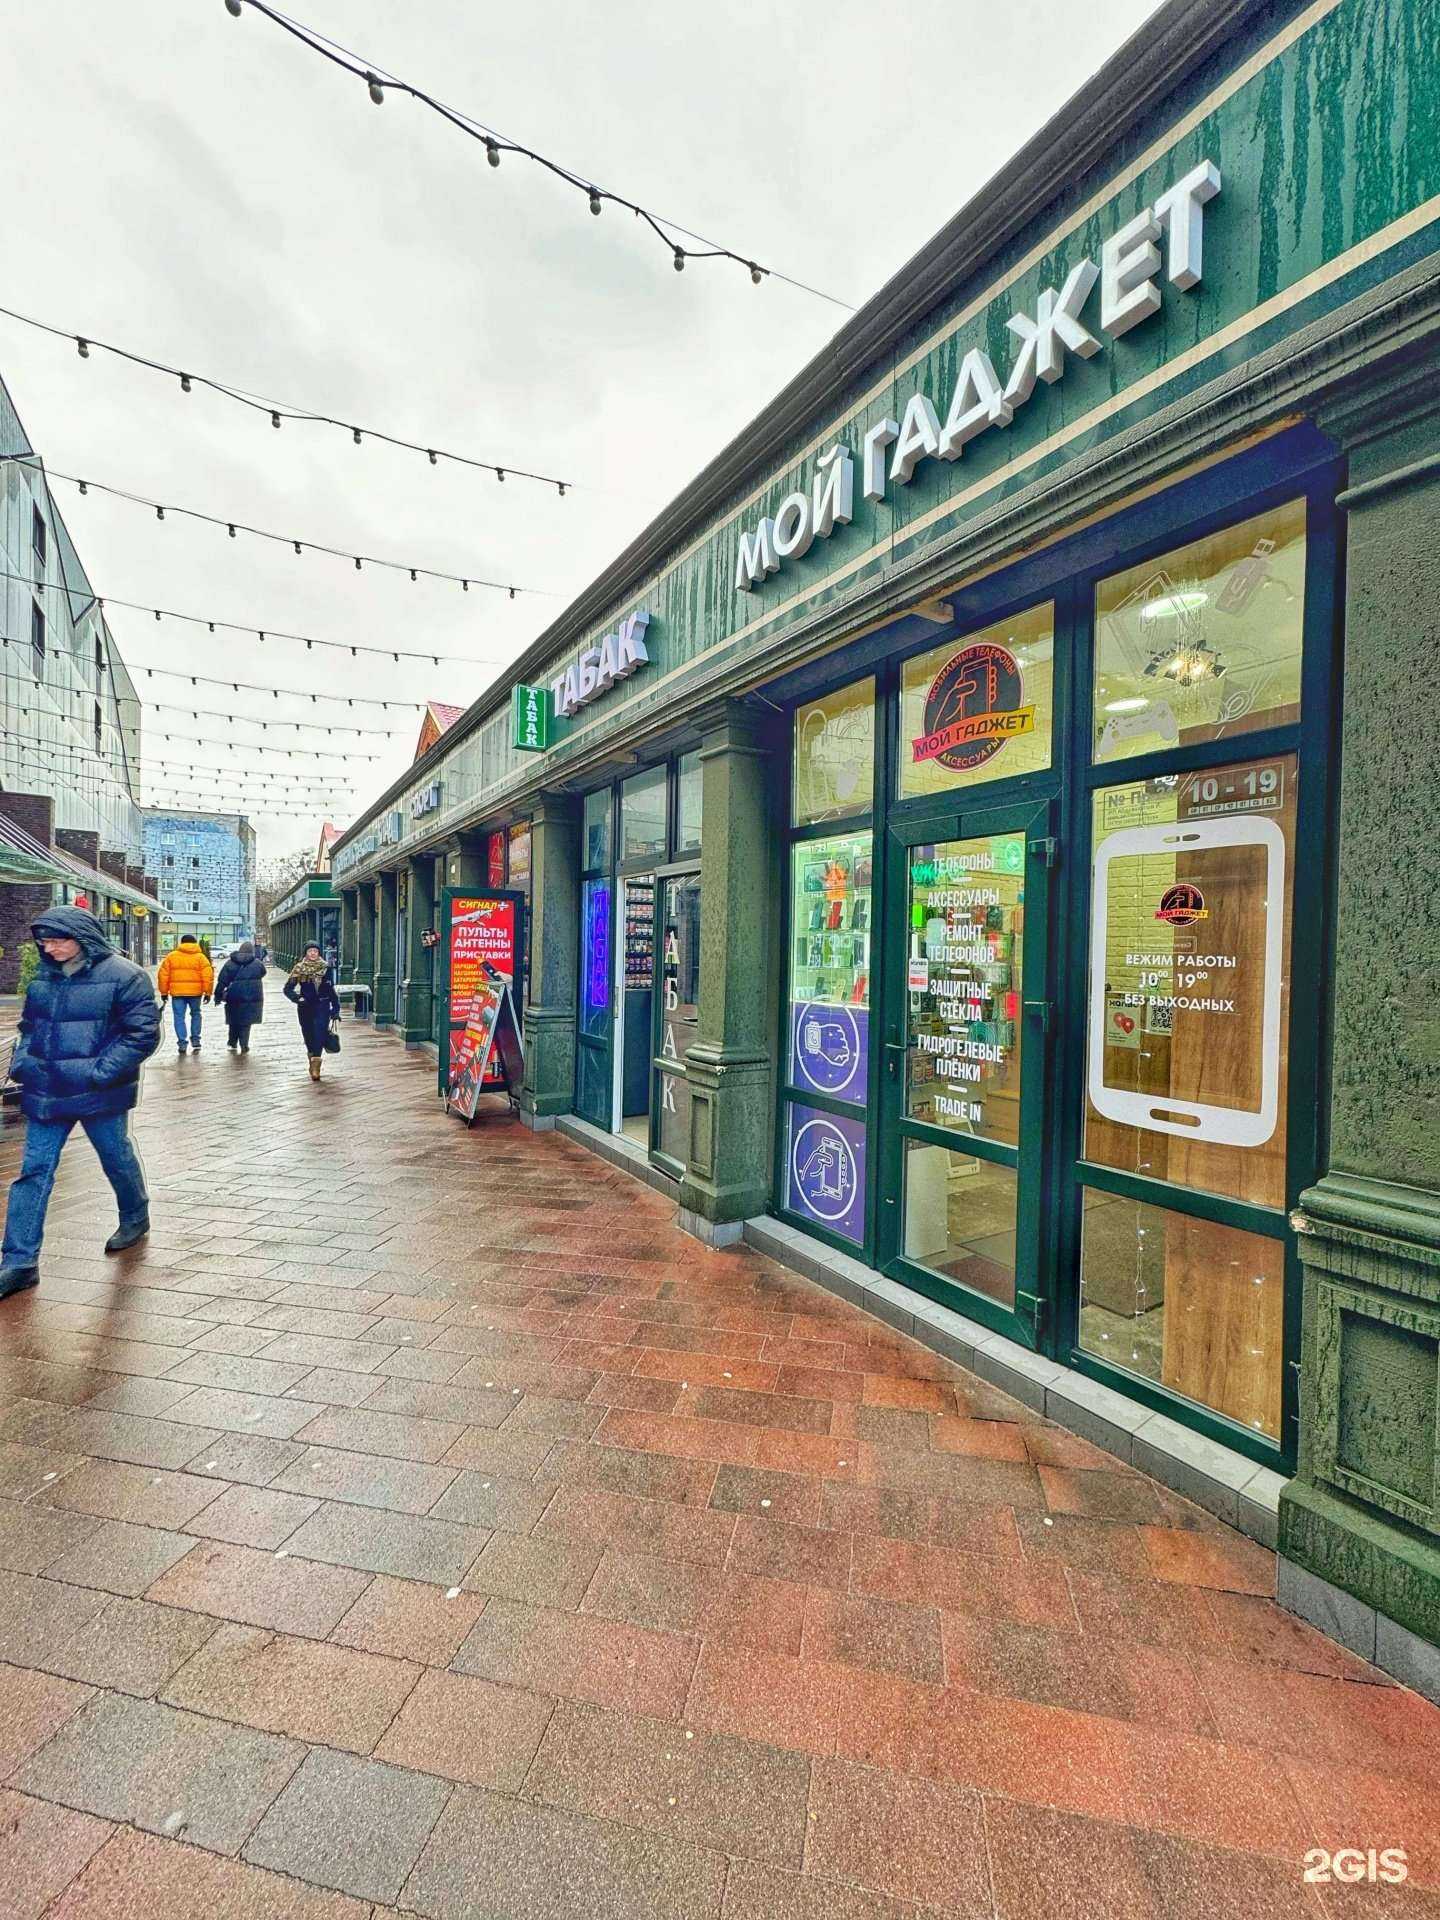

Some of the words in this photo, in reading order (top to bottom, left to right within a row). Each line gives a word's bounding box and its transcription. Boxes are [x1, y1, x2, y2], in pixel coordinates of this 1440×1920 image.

[735, 444, 853, 592] МОЙ
[863, 158, 1222, 502] ГАДЖЕТ
[551, 610, 649, 718] ТАБАК
[929, 649, 974, 702] МОБИЛЬНЫЕ
[975, 646, 1016, 677] ТЕЛЕФОНЫ
[526, 688, 538, 745] ТАБАК
[915, 727, 951, 757] МОЙ
[955, 713, 1030, 741] ГАДЖЕТ
[941, 737, 1000, 766] АКСЕССУАРЫ
[1189, 777, 1219, 803] 10
[1243, 768, 1278, 795] 19
[933, 852, 994, 874] ТЕЛЕФОНЫ
[927, 887, 1000, 908] АКСЕССУАРЫ
[454, 938, 511, 949] АНТЕННЫ
[458, 927, 508, 939] ПУЛЬТЫ
[940, 924, 983, 942] РЕМОНТ
[453, 950, 511, 960] ПРИСТАВКИ
[929, 944, 994, 964] ТЕЛЕФОНОВ
[1126, 954, 1173, 967] РЕЖИМ
[1177, 955, 1236, 968] РАБОТЫ
[661, 877, 682, 1113] ТАБАК
[930, 979, 992, 1000] ЗАЩИТНЫЕ
[940, 1000, 982, 1021] СТЁКЛА
[1124, 993, 1145, 1006] БЕЗ
[1149, 995, 1235, 1012] ВЫХОДНЫХ
[917, 1034, 1004, 1063] ГИДРОГЕЛЕВЫЕ
[936, 1057, 980, 1082] ПЛЁНКИ
[934, 1095, 967, 1120] TRADE
[969, 1103, 981, 1122] IN
